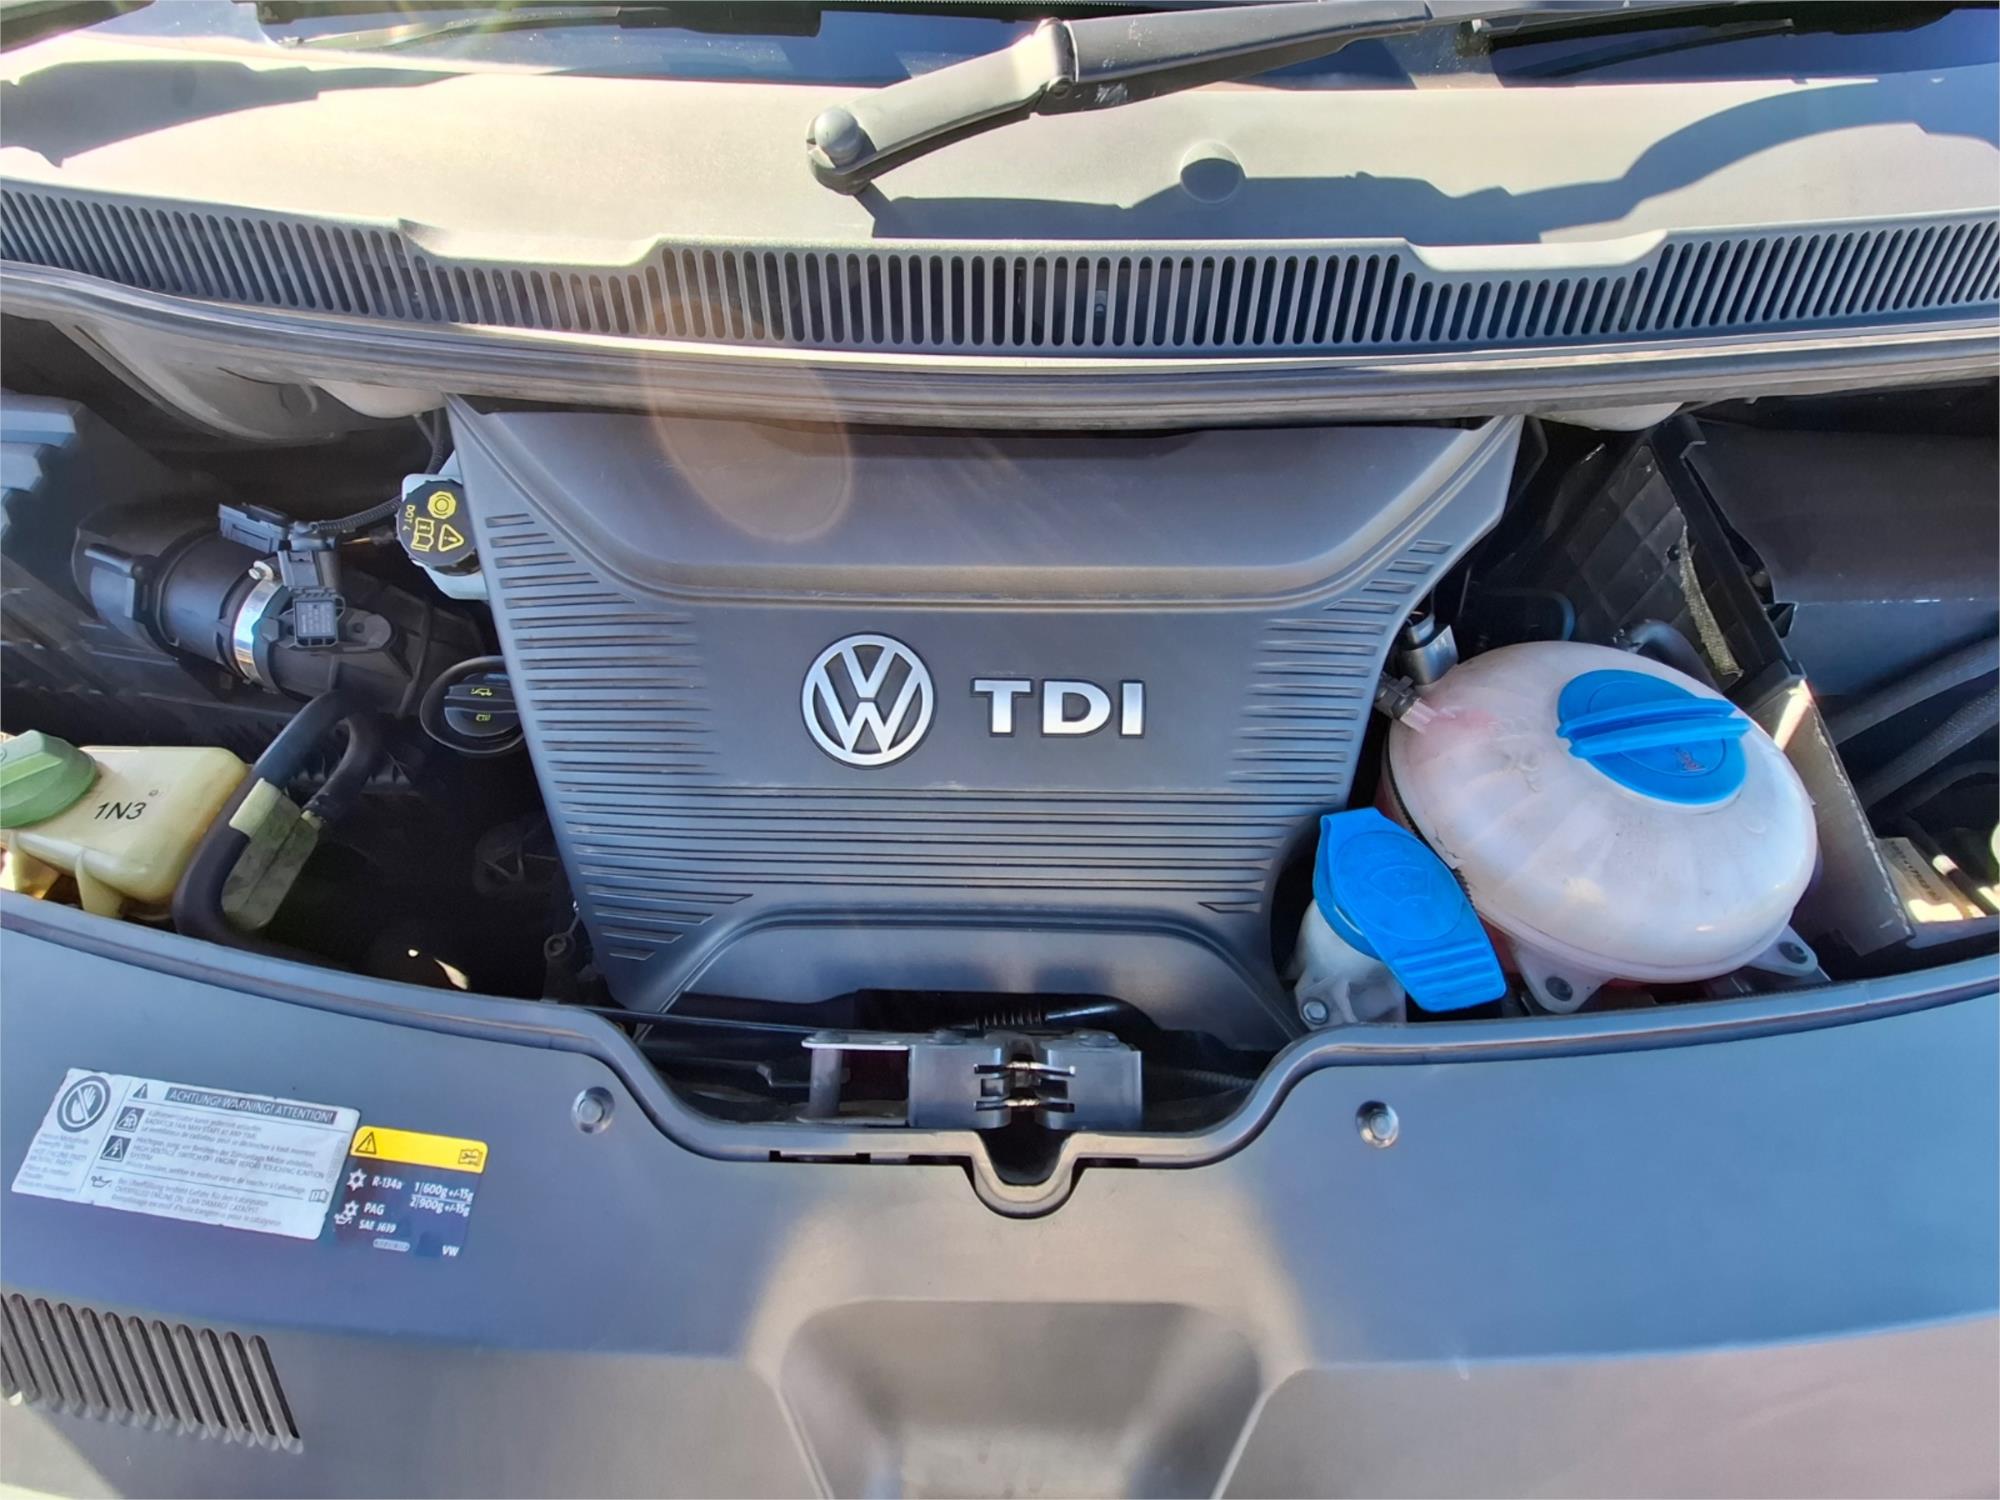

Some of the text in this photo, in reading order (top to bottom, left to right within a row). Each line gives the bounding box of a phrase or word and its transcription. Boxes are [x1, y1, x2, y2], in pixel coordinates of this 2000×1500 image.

[404, 504, 416, 524] DOT
[802, 633, 1146, 767] VW TDI
[94, 802, 147, 820] 1N3
[169, 1090, 220, 1106] ACHTUNG!
[222, 1097, 274, 1114] WARNING!
[275, 1105, 334, 1124] ATTENTION!
[372, 1175, 402, 1190] R-134a
[363, 1202, 385, 1216] PAG
[441, 1244, 460, 1257] VW
